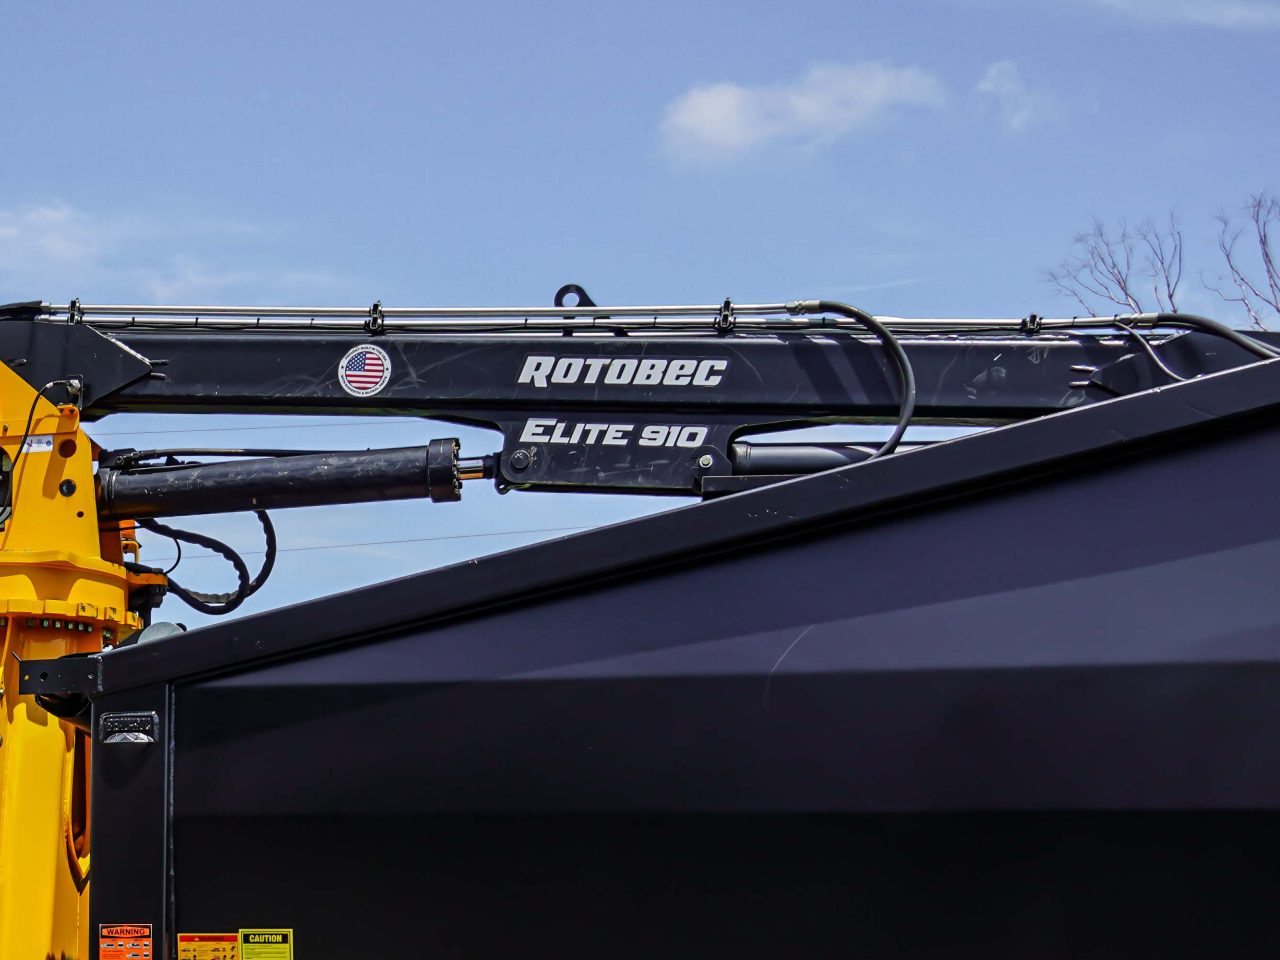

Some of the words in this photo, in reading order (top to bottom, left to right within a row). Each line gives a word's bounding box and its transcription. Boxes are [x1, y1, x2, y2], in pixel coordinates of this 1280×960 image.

[638, 424, 709, 448] 910
[106, 928, 145, 936] WARNING
[249, 934, 283, 943] CAUTION
